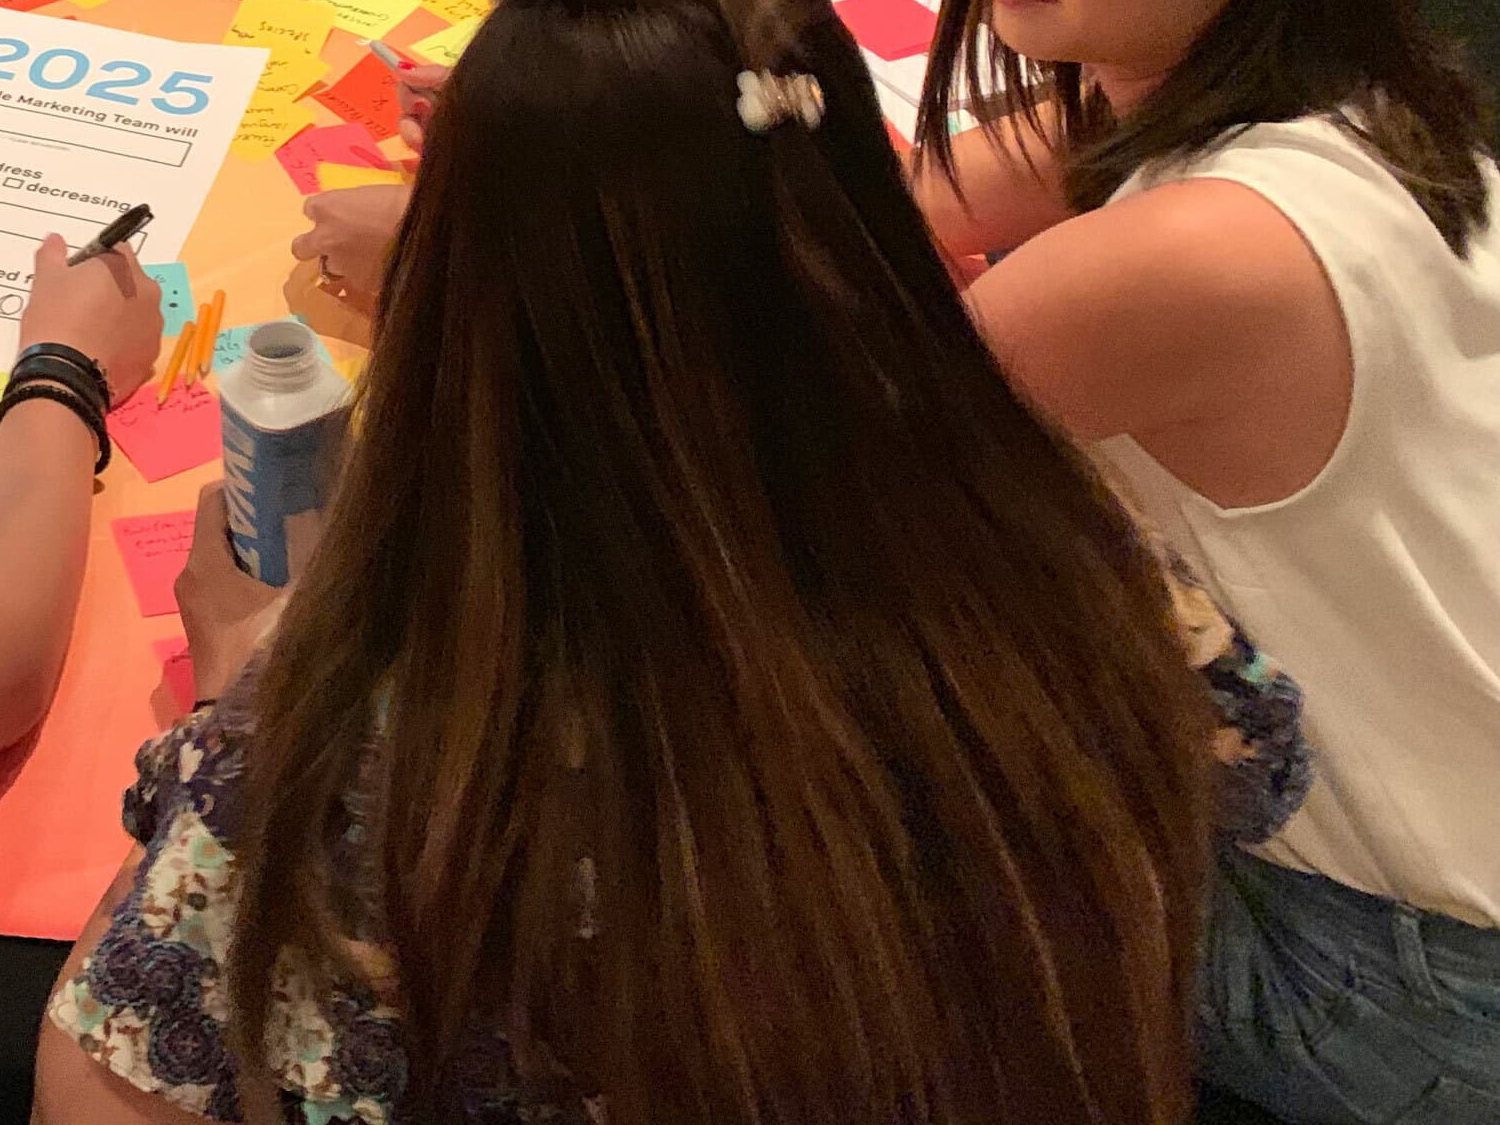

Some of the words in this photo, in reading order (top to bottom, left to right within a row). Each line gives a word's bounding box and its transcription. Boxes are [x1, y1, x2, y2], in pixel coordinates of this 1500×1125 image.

[16, 94, 107, 123] Marketing
[112, 114, 160, 133] Team
[164, 125, 199, 139] will
[25, 180, 133, 214] decreasing
